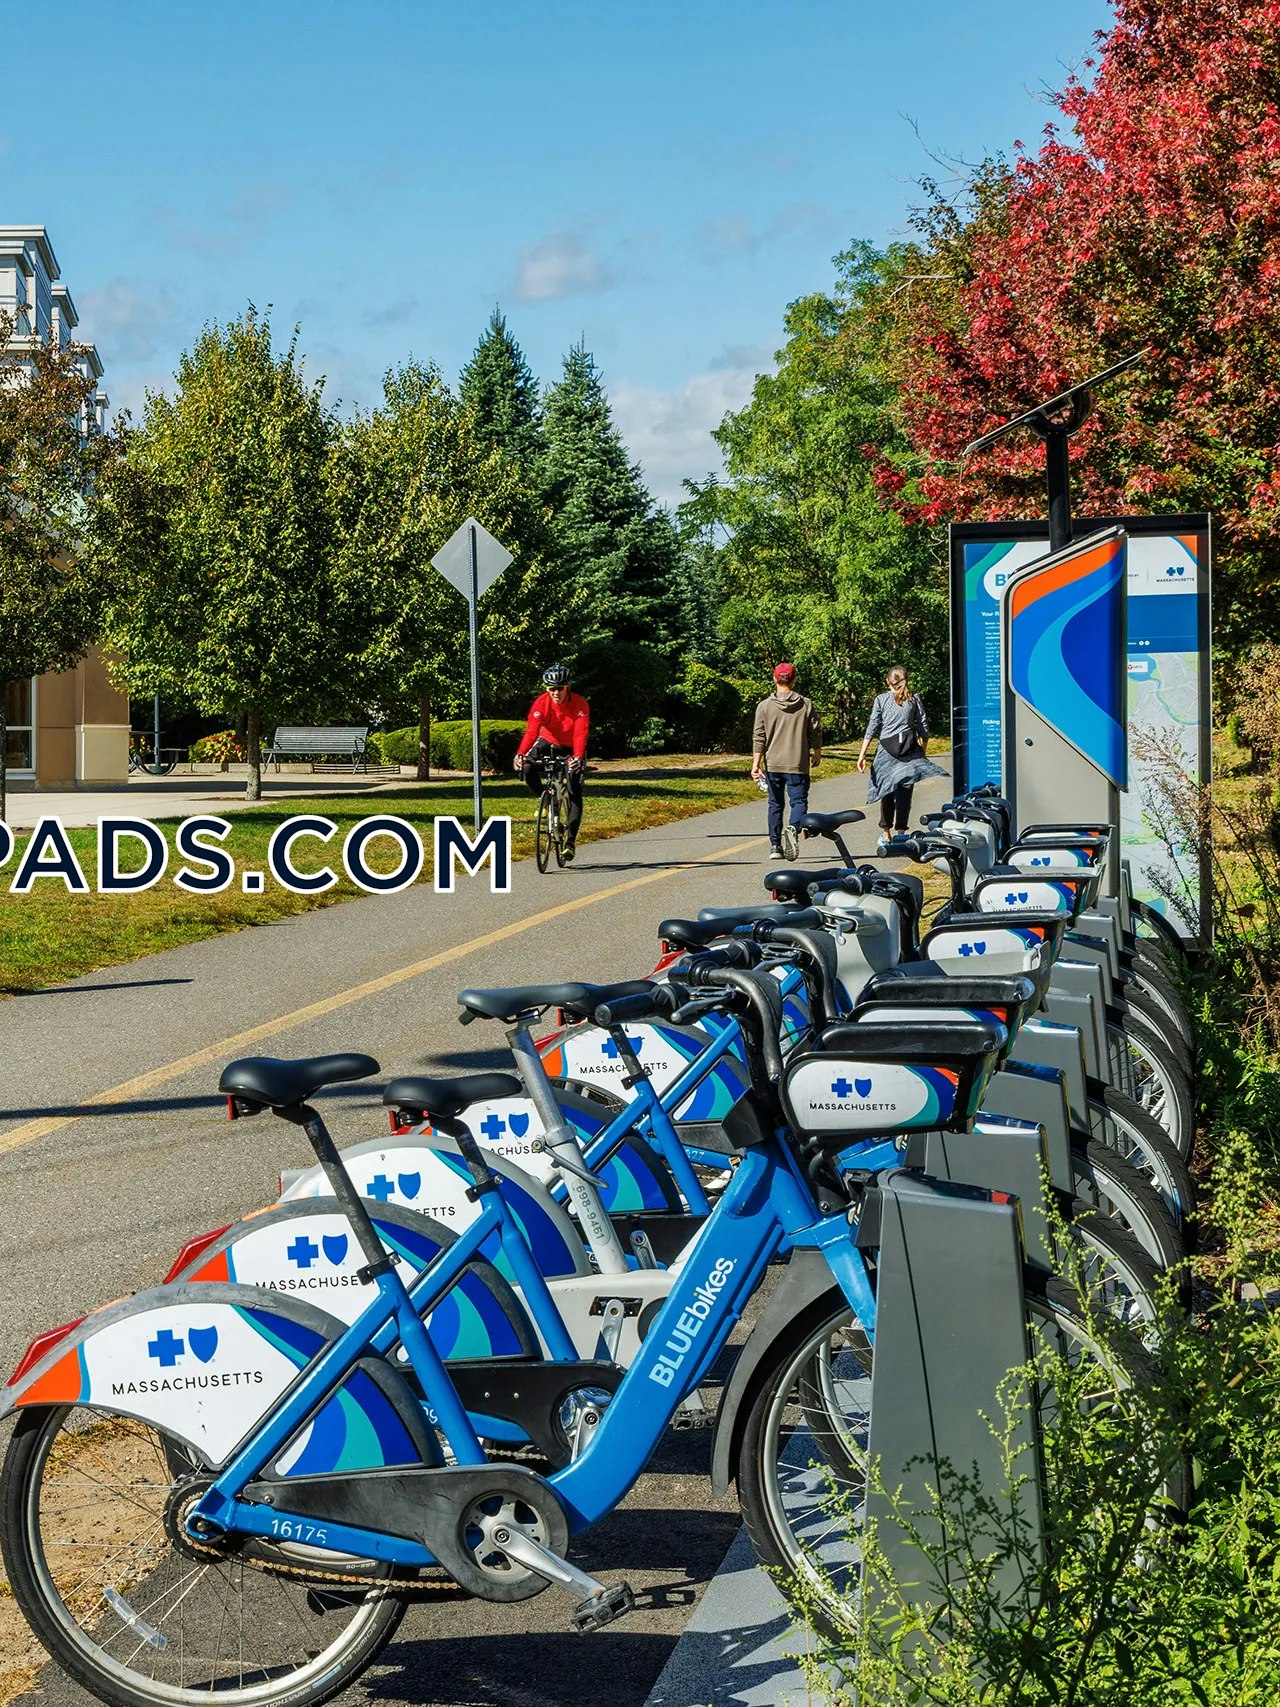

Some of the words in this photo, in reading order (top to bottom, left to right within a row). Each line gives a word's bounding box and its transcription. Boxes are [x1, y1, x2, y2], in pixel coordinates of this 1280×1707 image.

[580, 1061, 668, 1075] MASSACHETTS
[809, 1102, 897, 1112] MASSACHUSETTS
[576, 1185, 605, 1240] 698-9461
[256, 1275, 360, 1291] MASSACHUSE
[112, 1371, 264, 1396] MASSACHUSETTS
[271, 1519, 328, 1544] 16175
